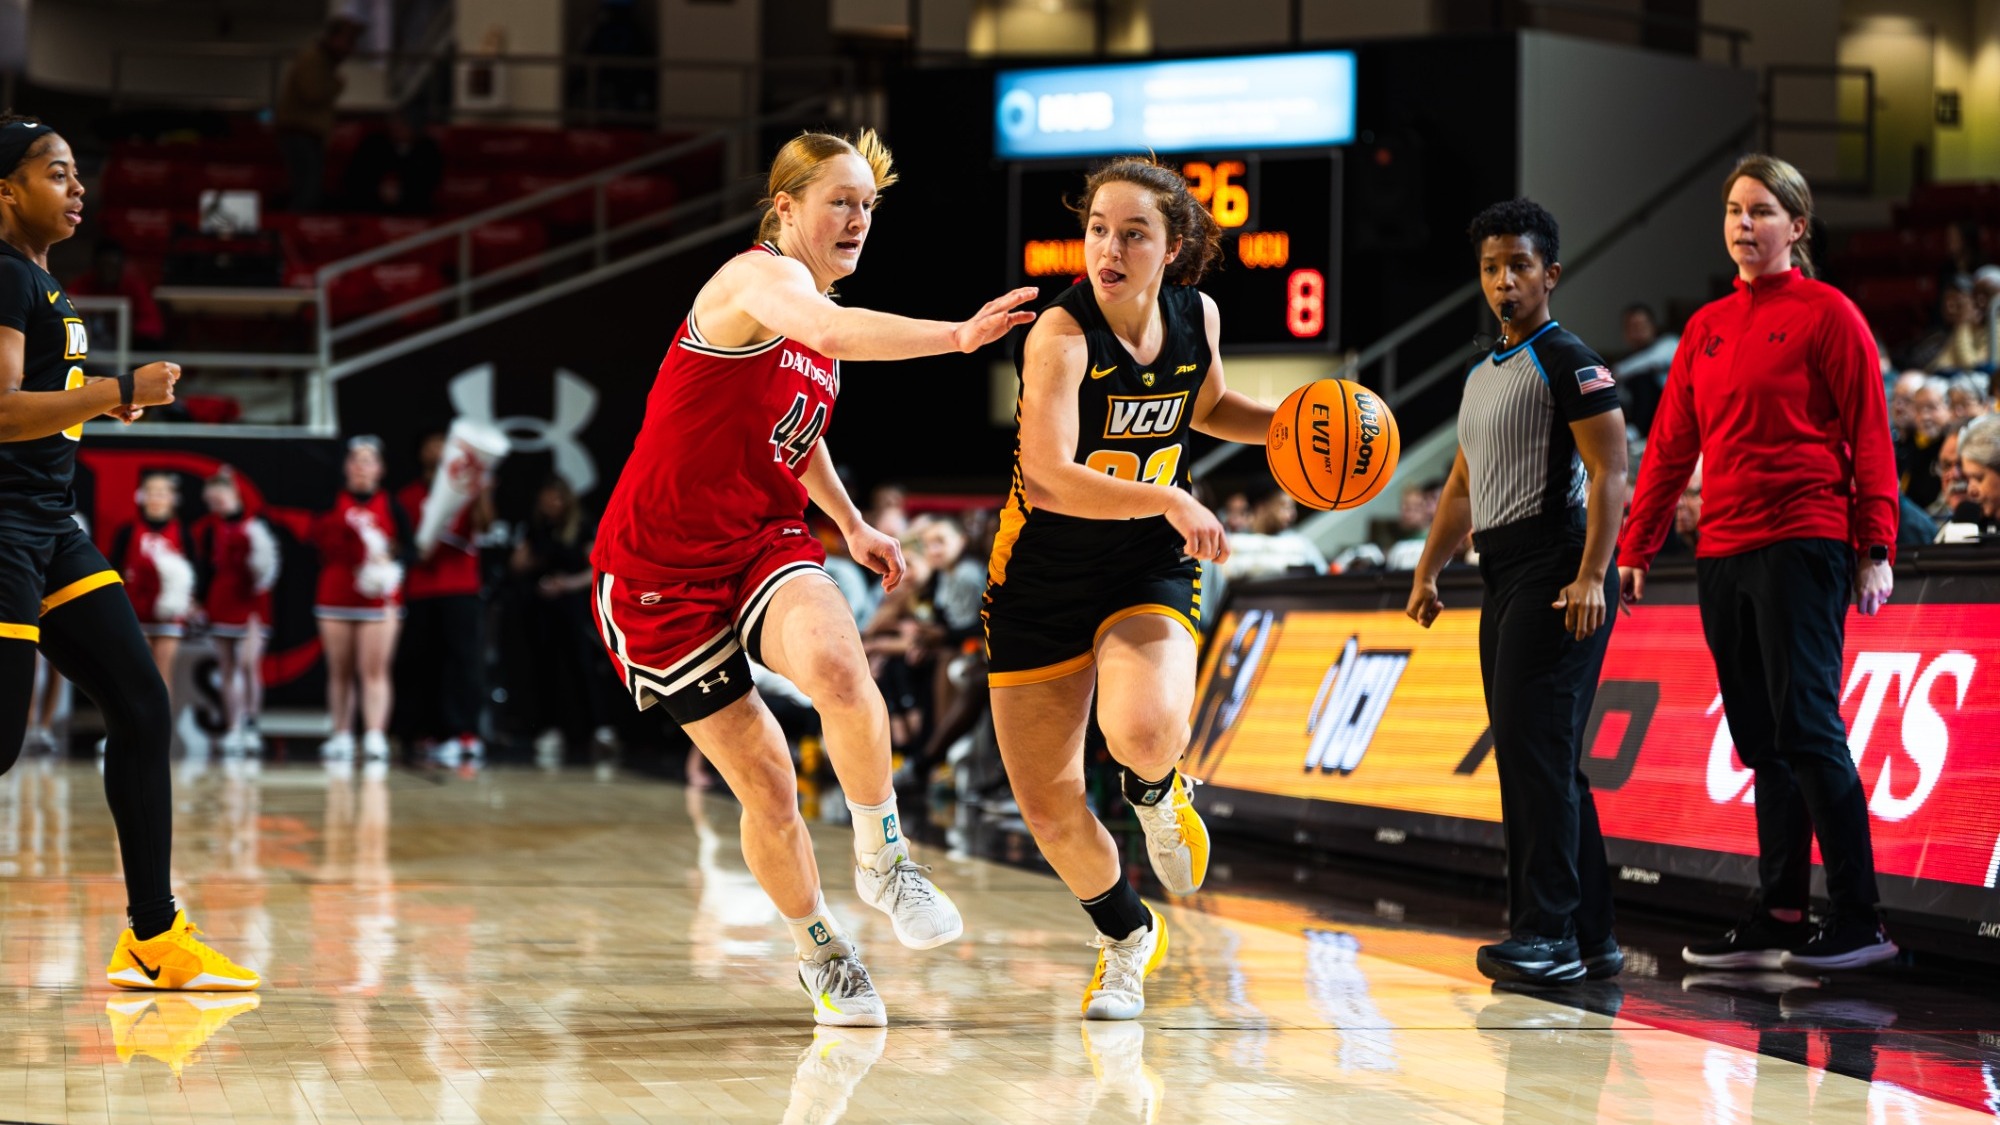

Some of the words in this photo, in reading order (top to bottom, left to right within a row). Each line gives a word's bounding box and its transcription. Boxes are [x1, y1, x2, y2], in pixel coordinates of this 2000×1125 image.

[1288, 269, 1325, 337] 8
[768, 391, 828, 470] 44
[1108, 396, 1184, 435] VCU
[1312, 403, 1331, 456] EVO
[1353, 391, 1381, 476] Wilson
